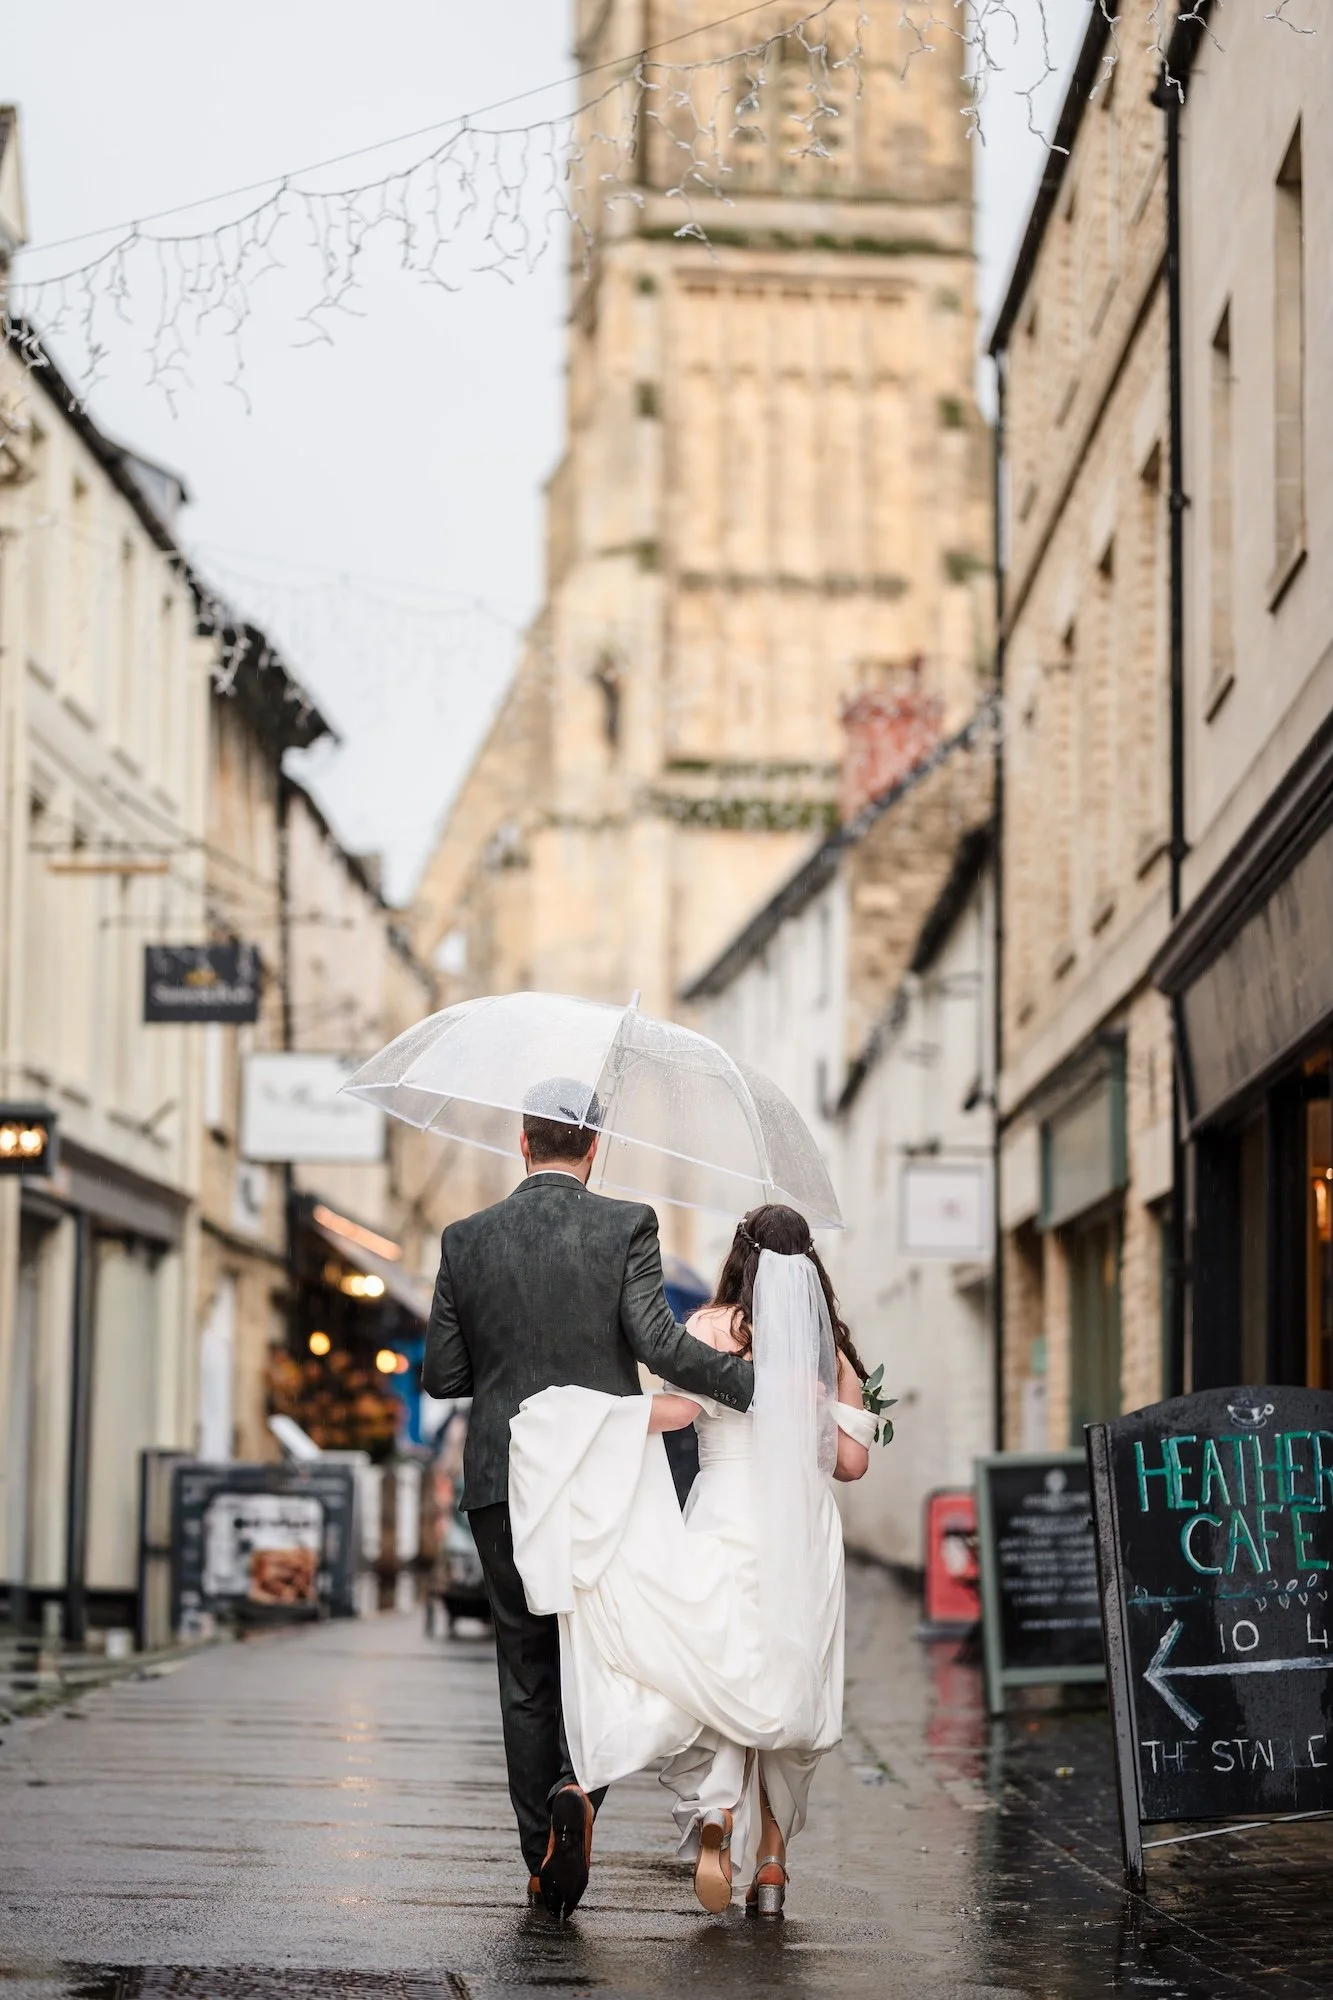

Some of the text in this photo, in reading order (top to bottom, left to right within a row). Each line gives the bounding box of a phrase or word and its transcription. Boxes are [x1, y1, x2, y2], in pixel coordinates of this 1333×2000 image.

[1181, 1504, 1330, 1575] CAFE
[1219, 1612, 1328, 1653] 10 4
[1141, 1740, 1199, 1774] THE
